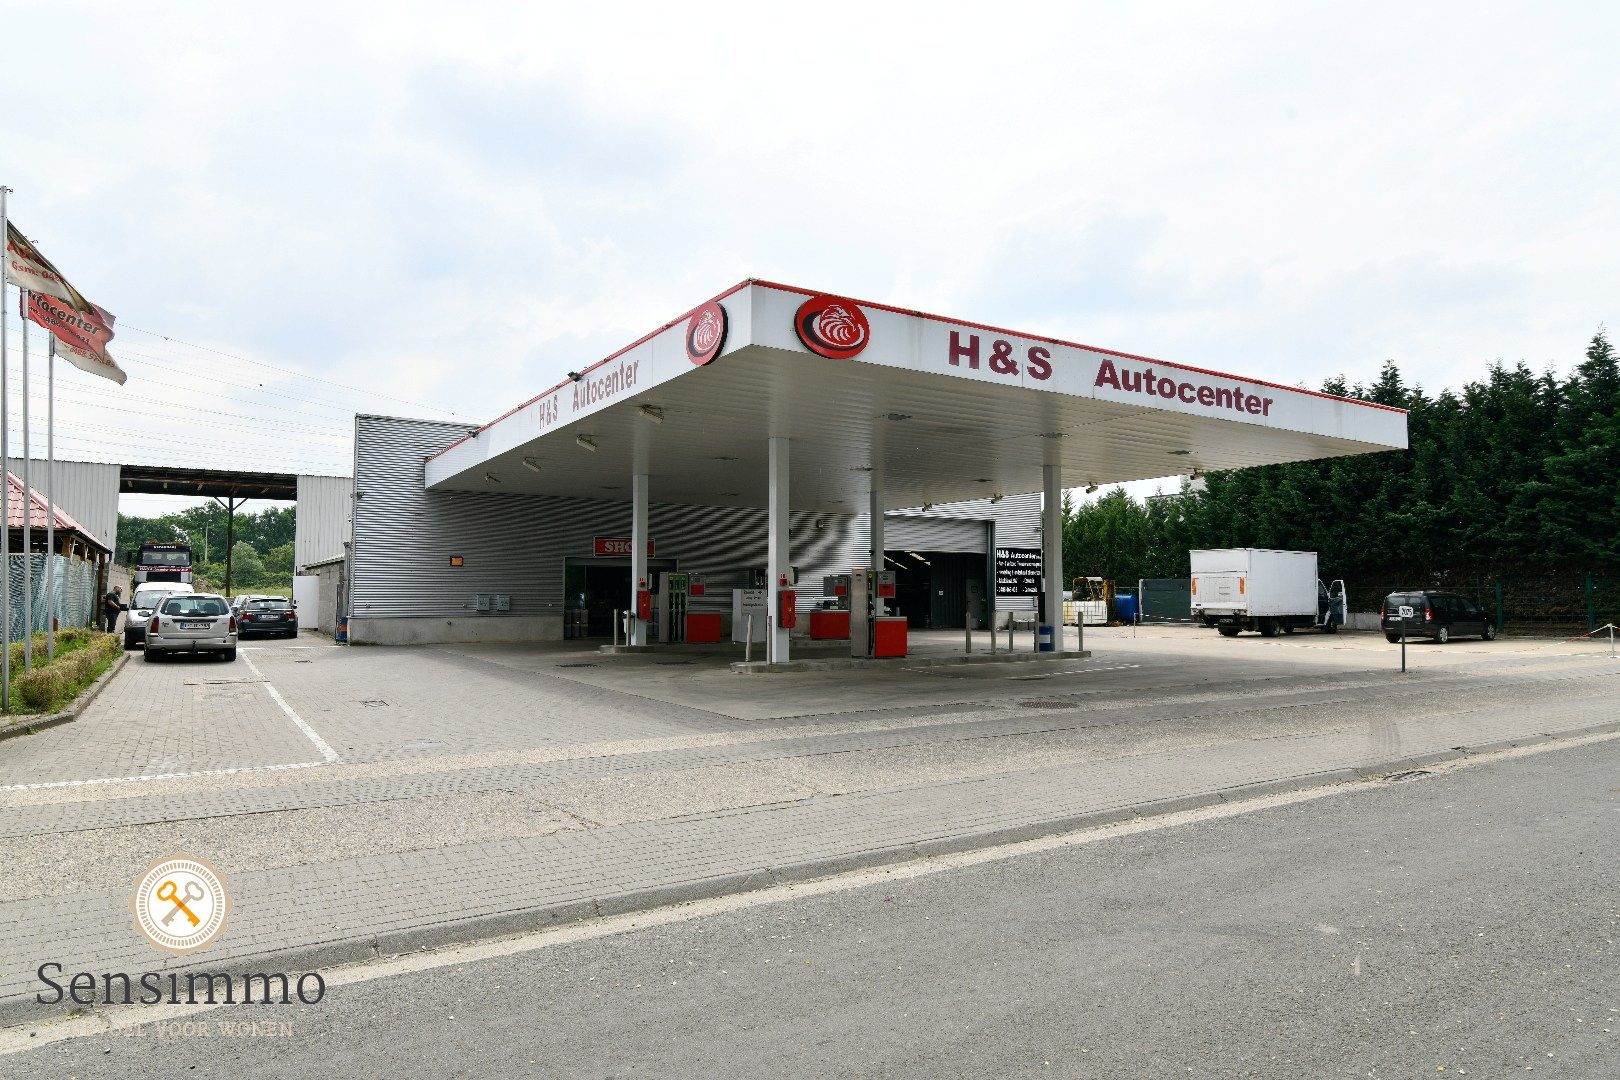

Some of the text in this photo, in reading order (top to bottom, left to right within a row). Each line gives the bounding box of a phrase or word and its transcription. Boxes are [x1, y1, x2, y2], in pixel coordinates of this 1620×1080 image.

[572, 359, 640, 412] Autocenter
[1094, 358, 1274, 417] Autocenter
[604, 541, 633, 553] SHO
